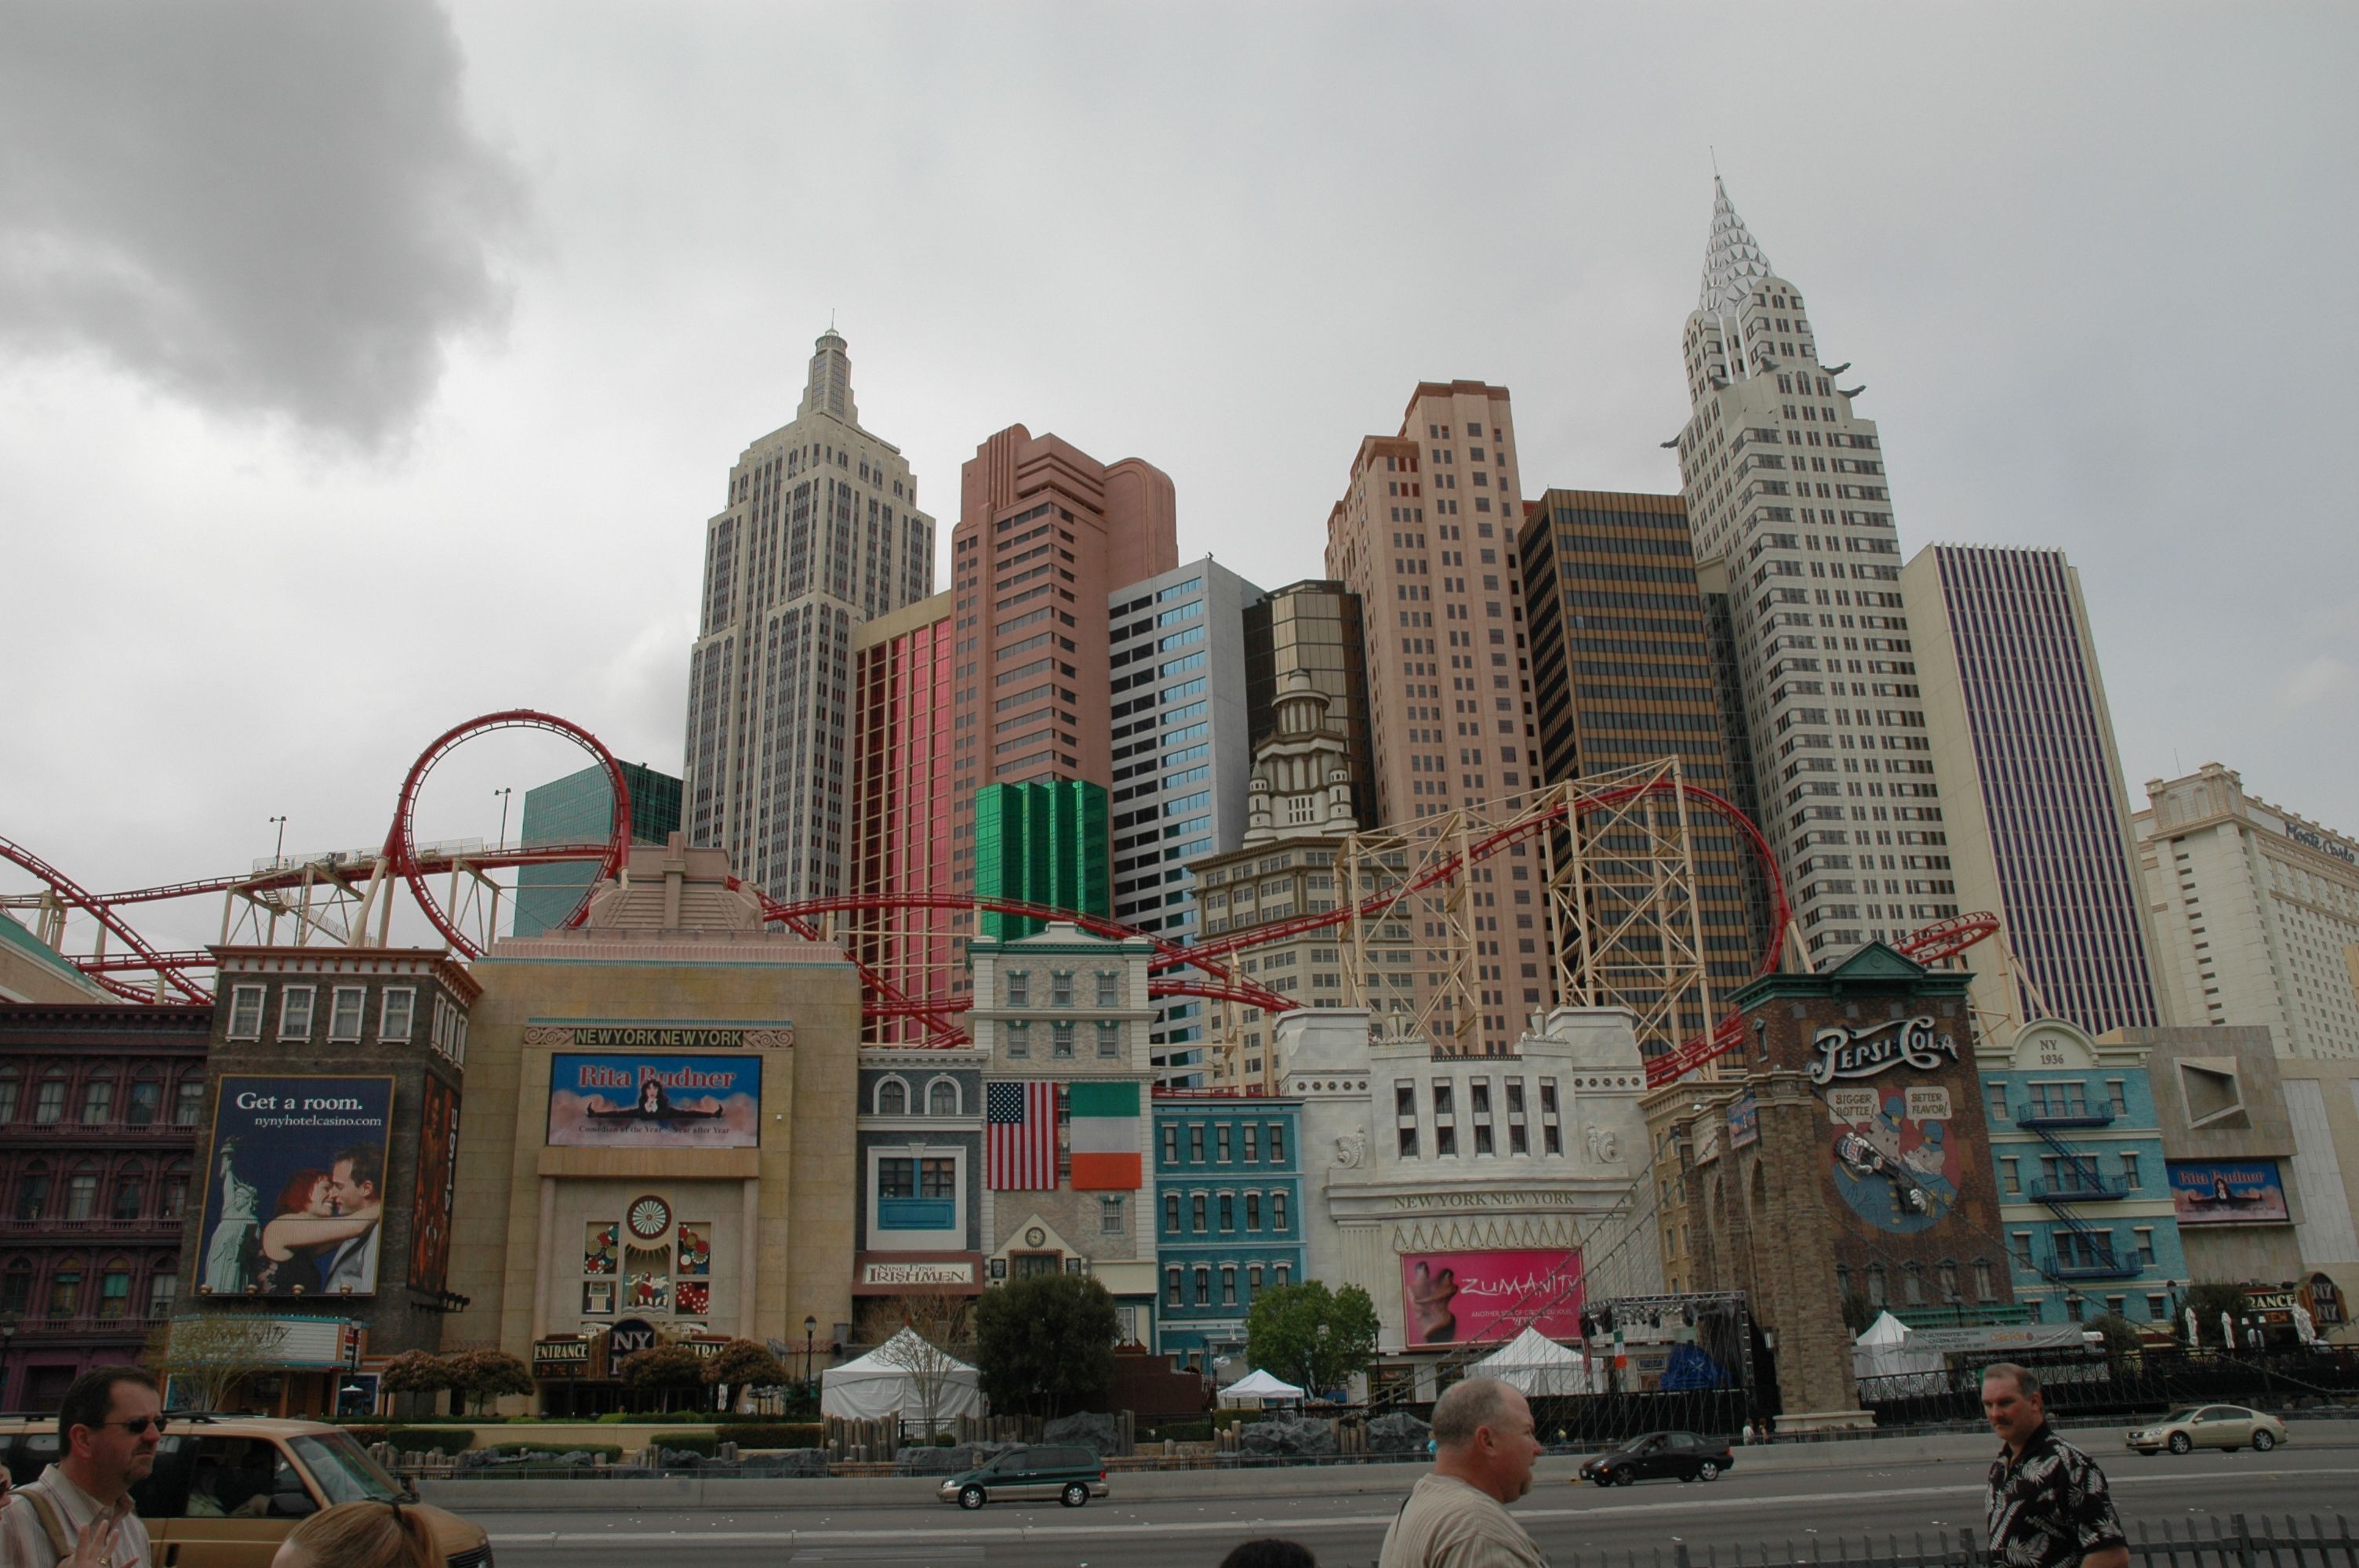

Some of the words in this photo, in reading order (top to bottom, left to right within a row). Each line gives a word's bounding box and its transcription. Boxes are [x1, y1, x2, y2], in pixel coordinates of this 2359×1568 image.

[2284, 821, 2321, 849] Monte
[2323, 840, 2355, 863] Carlo
[576, 1029, 612, 1044] NEW
[613, 1029, 657, 1044] YORK
[660, 1030, 696, 1045] NEW
[699, 1031, 742, 1046] YORK
[2039, 1040, 2057, 1051] NY
[2040, 1054, 2064, 1065] 1936
[580, 1065, 631, 1087] Rita
[638, 1066, 736, 1088] Rudner
[236, 1092, 278, 1109] Get
[284, 1098, 296, 1109] a
[304, 1097, 363, 1110] room.
[1835, 1094, 1872, 1105] BIGGER
[1911, 1093, 1943, 1102] BETTER
[1835, 1104, 1875, 1119] BOTTLE!
[1912, 1102, 1948, 1116] FLAVOR!
[255, 1115, 381, 1128] nynyhotelcasino.com
[2178, 1171, 2208, 1185] Rita
[1394, 1196, 1434, 1209] NEW
[1438, 1194, 1487, 1207] YORK
[1490, 1193, 1527, 1205] NEW
[1528, 1192, 1575, 1205] YORK
[870, 1268, 965, 1283] IRISHMEN
[2312, 1283, 2334, 1300] NY
[2316, 1305, 2339, 1321] NY
[612, 1330, 652, 1350] NY
[536, 1344, 587, 1359] ENTRANCE
